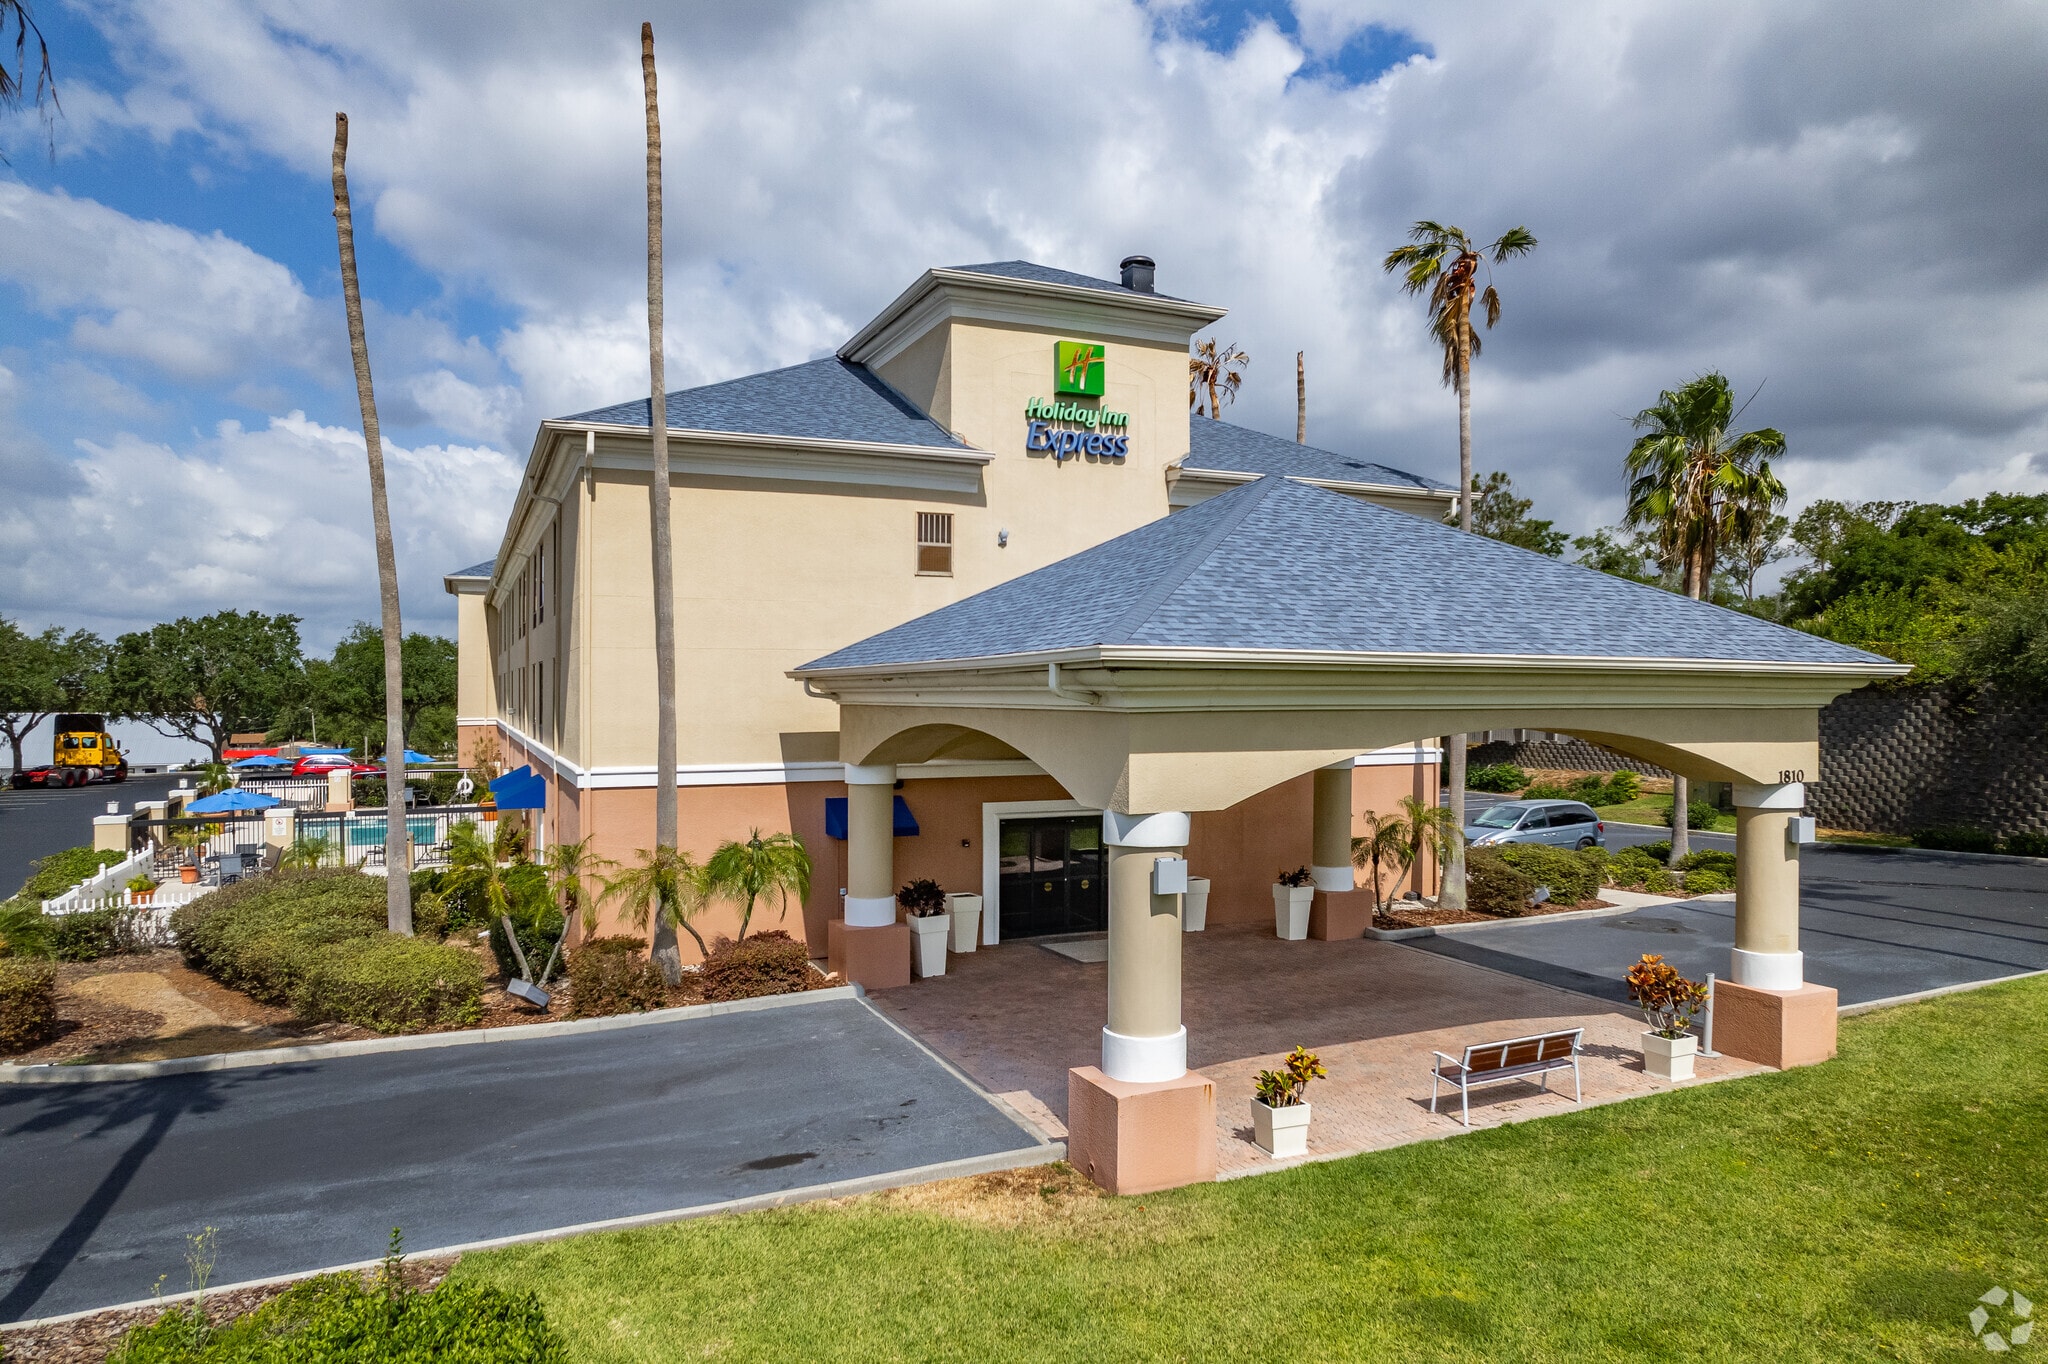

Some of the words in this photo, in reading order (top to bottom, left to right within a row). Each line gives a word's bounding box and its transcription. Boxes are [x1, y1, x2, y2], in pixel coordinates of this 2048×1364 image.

[1026, 397, 1099, 428] Holiday
[1101, 404, 1130, 426] Inn
[1026, 420, 1130, 459] Express
[1778, 769, 1804, 784] 1810
